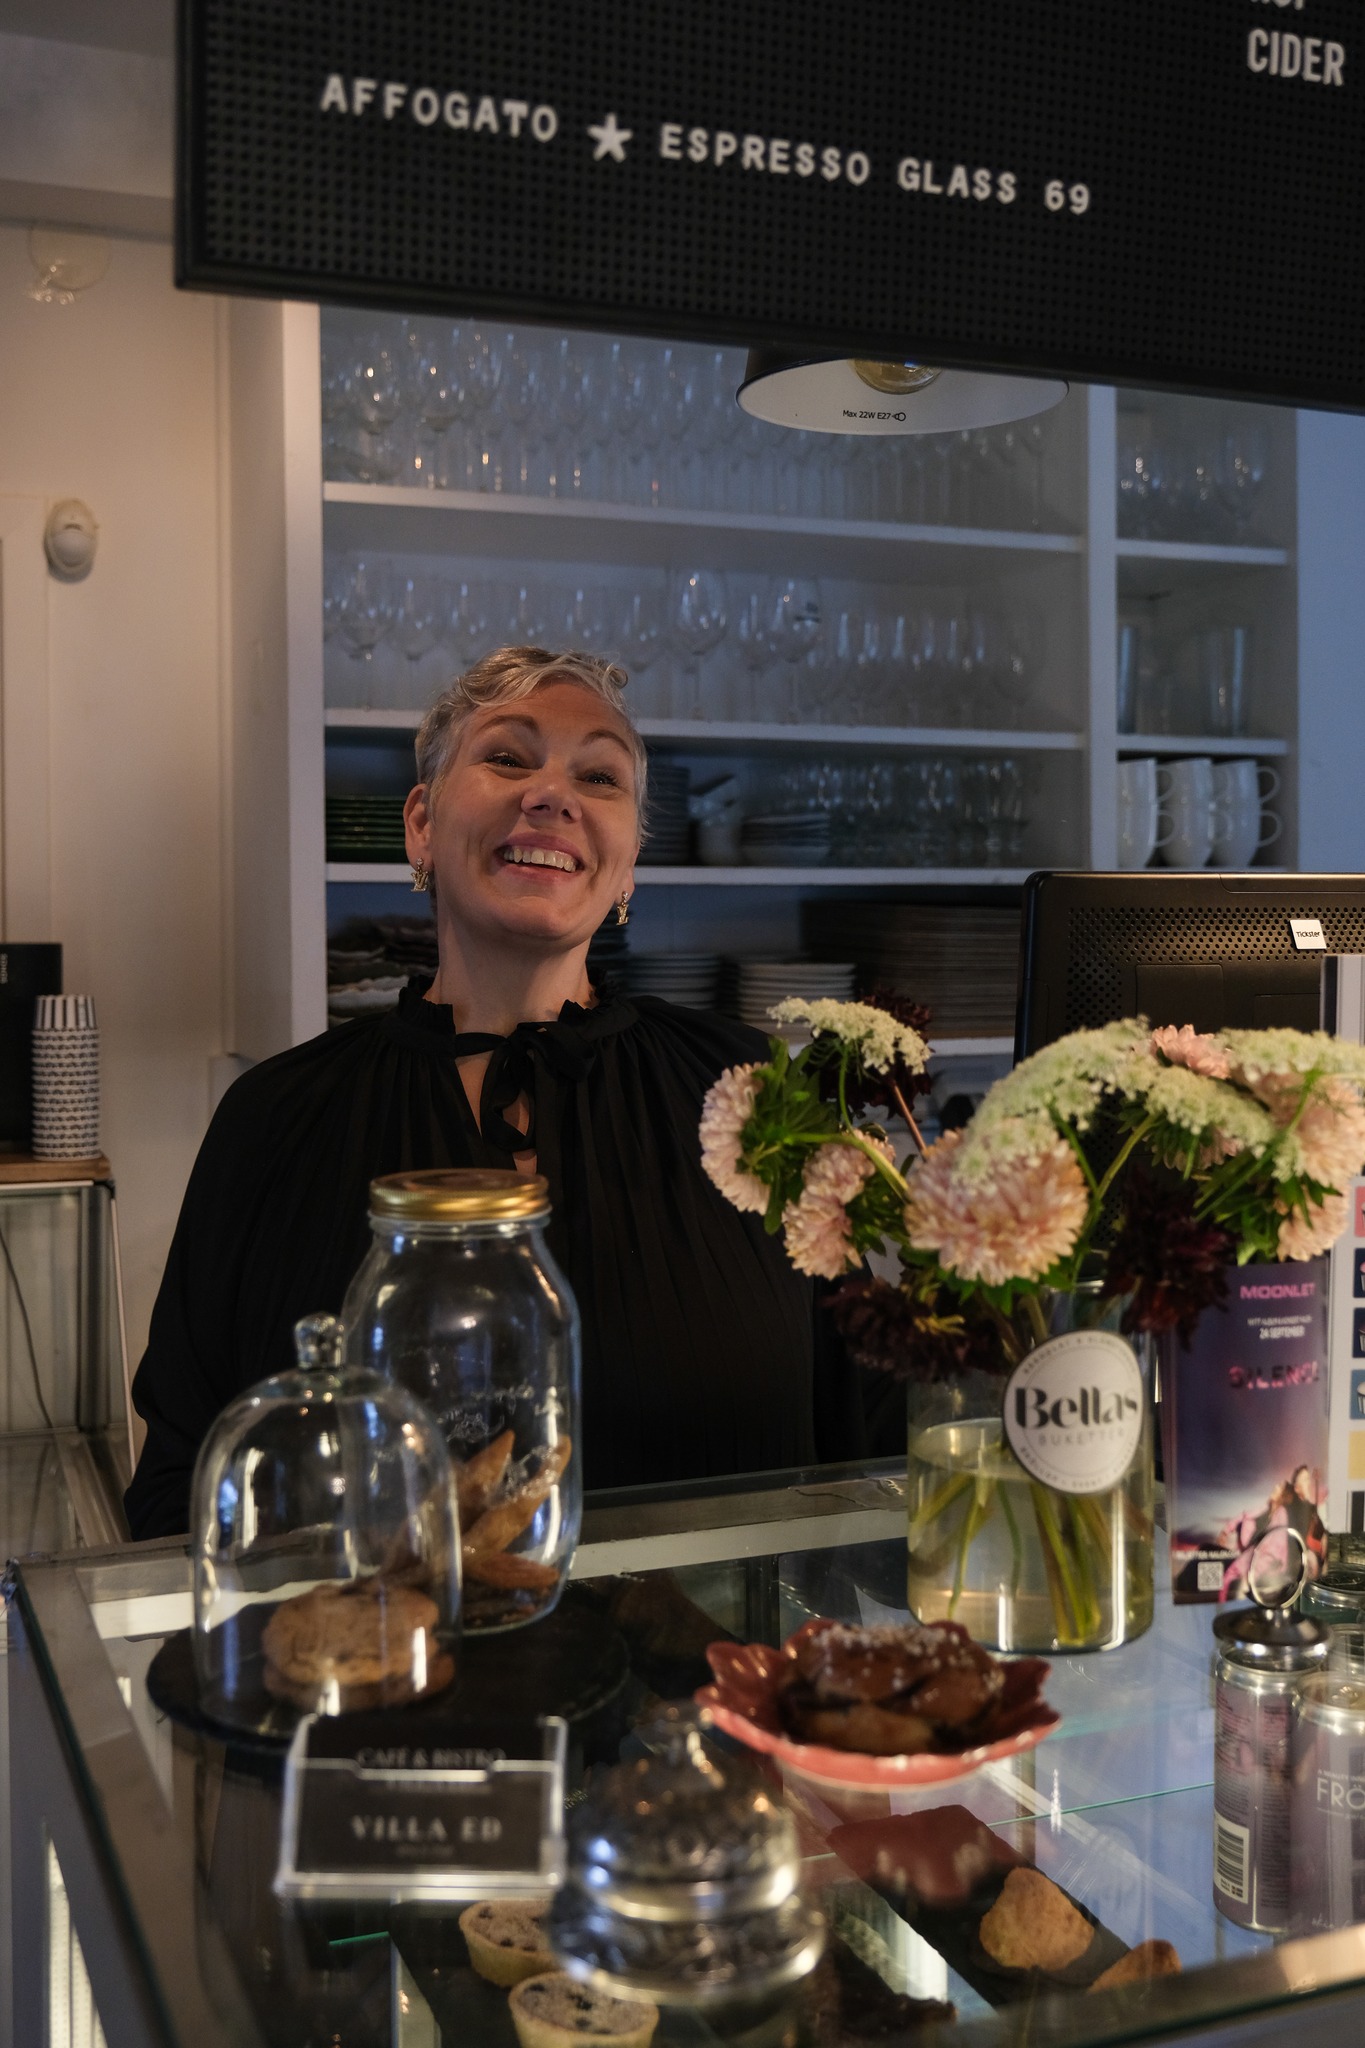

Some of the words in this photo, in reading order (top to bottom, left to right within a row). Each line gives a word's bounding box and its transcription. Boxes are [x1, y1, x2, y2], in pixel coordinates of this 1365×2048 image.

[1247, 28, 1345, 87] CIDER
[319, 73, 558, 143] AFFOGATO
[660, 122, 871, 186] ESPRESSO
[897, 157, 1017, 204] GLASS
[1044, 179, 1091, 215] 69
[843, 410, 857, 418] Max
[859, 411, 876, 419] 22W
[1240, 1282, 1316, 1299] MOONLET
[1015, 1386, 1138, 1429] Bellas
[351, 1815, 448, 1842] VILLA
